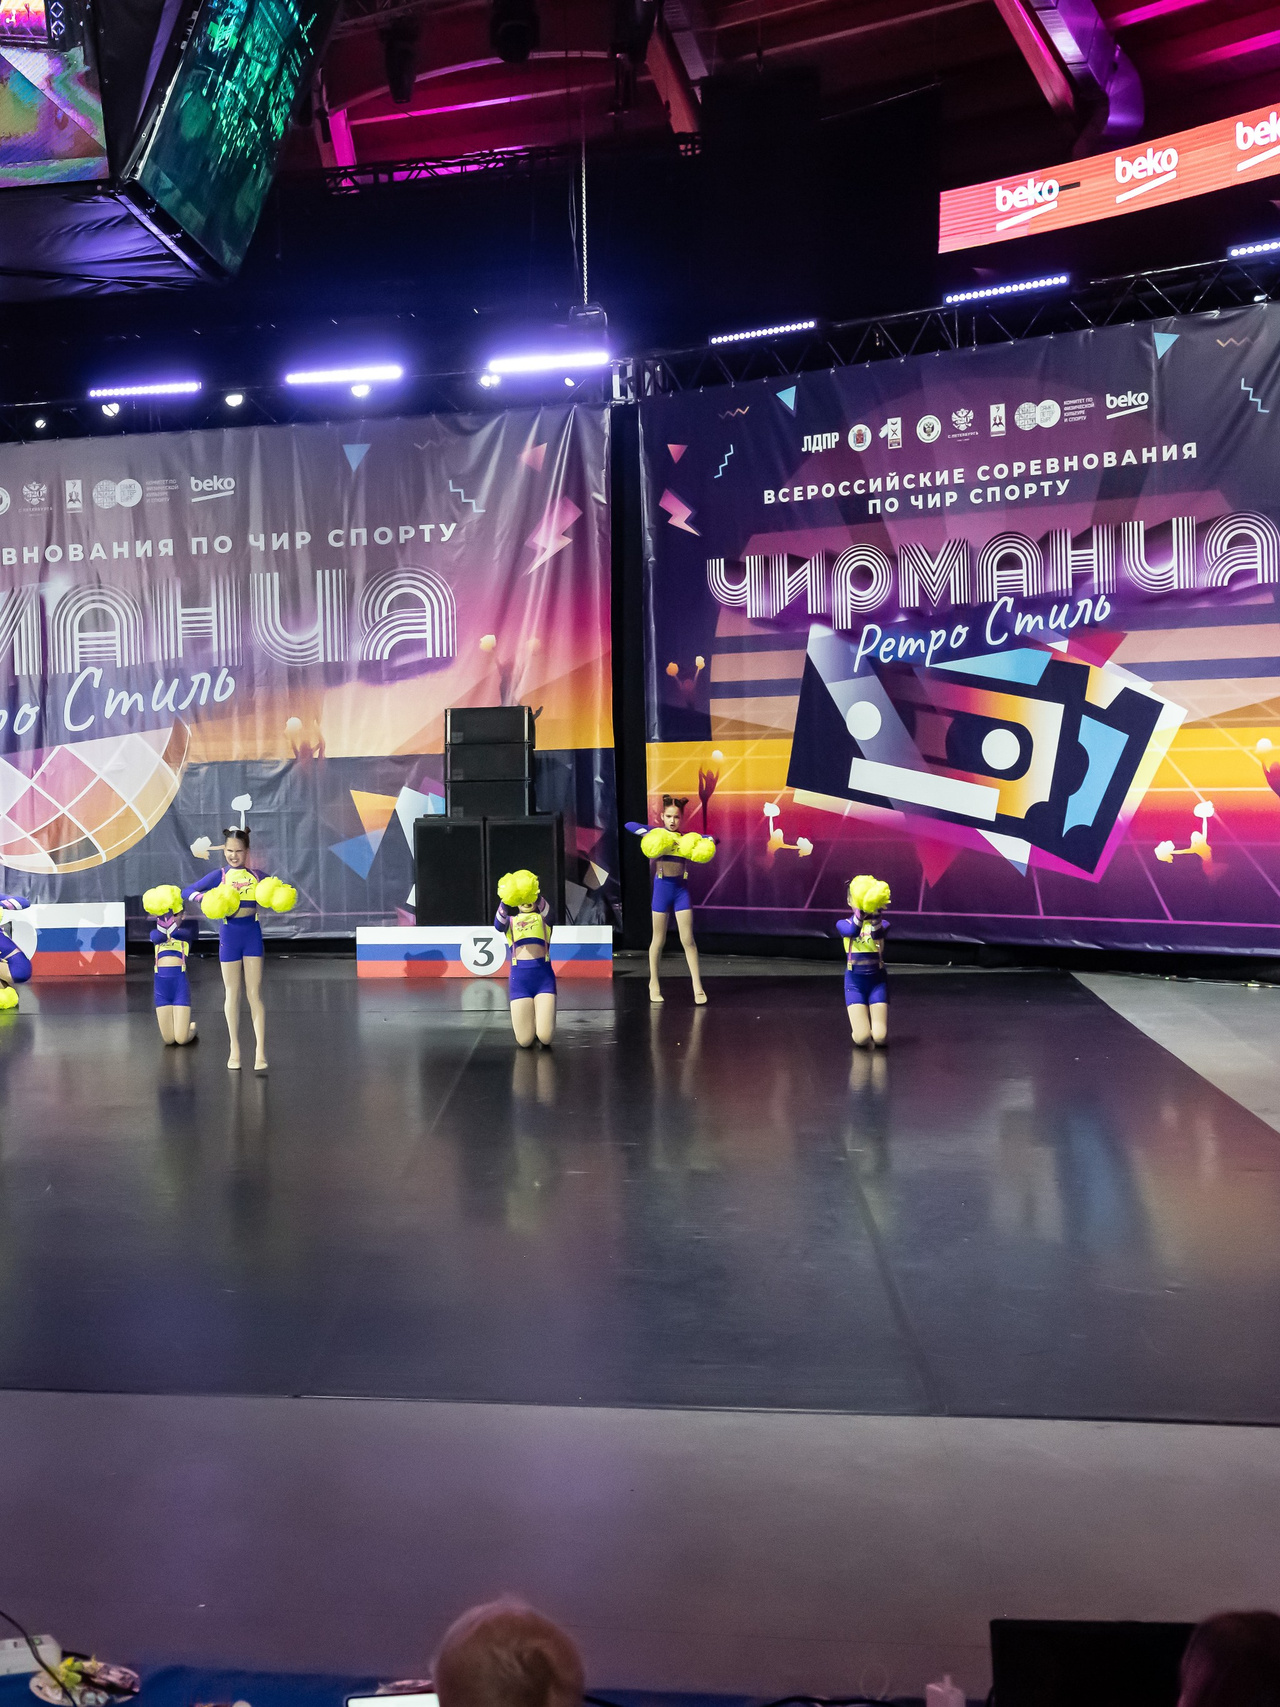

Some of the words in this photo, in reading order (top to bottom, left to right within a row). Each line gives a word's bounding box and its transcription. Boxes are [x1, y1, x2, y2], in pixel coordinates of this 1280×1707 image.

[1235, 111, 1280, 151] bek
[1115, 147, 1179, 184] beko
[995, 178, 1060, 212] beko
[1105, 390, 1149, 409] beko
[802, 432, 840, 453] ЛДПР
[191, 475, 236, 492] beko
[763, 467, 966, 505] ВСЕРОССИЙСКИЕ
[977, 442, 1198, 483] СОРЕВНОВАНИЯ
[868, 497, 900, 515] ПО
[910, 491, 960, 510] ЧИР
[970, 479, 1070, 506] СПОРТУ
[191, 533, 234, 555] ПО
[248, 529, 313, 550] ЧИР
[328, 522, 458, 548] СПОРТУ
[853, 623, 969, 673] Ретро
[985, 594, 1111, 648] Стиль
[63, 666, 236, 734] Стиль
[472, 937, 495, 967] 3
